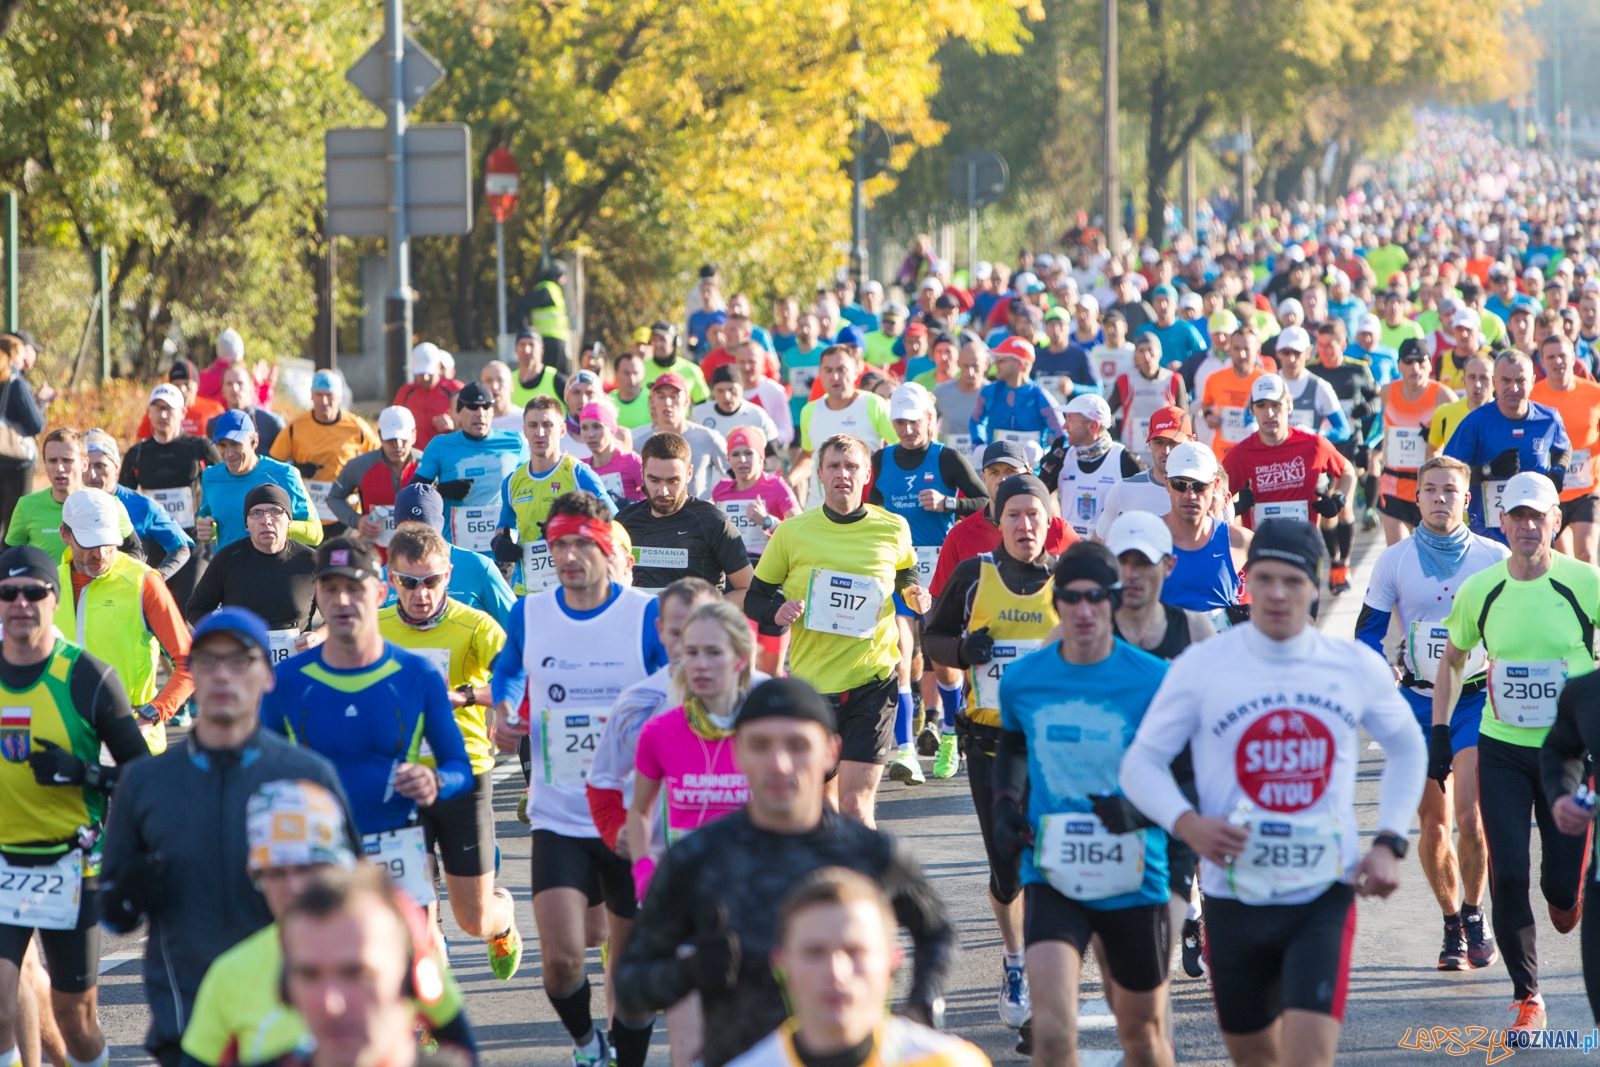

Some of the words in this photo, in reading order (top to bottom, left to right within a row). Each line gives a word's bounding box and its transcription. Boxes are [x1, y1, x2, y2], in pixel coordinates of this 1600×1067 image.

[1256, 466, 1306, 487] SZPIKU
[467, 520, 496, 534] 665
[640, 558, 686, 566] INVESTMENT
[642, 548, 686, 557] POSNANIA
[829, 591, 868, 611] 5117
[1503, 682, 1558, 699] 2306
[1212, 693, 1288, 738] FABRYKA
[565, 733, 601, 753] 24
[1244, 738, 1328, 773] SUSHI
[1257, 781, 1315, 807] 4YOU
[1060, 841, 1123, 865] 3164
[1252, 843, 1325, 868] 2837
[0, 870, 64, 895] 2722
